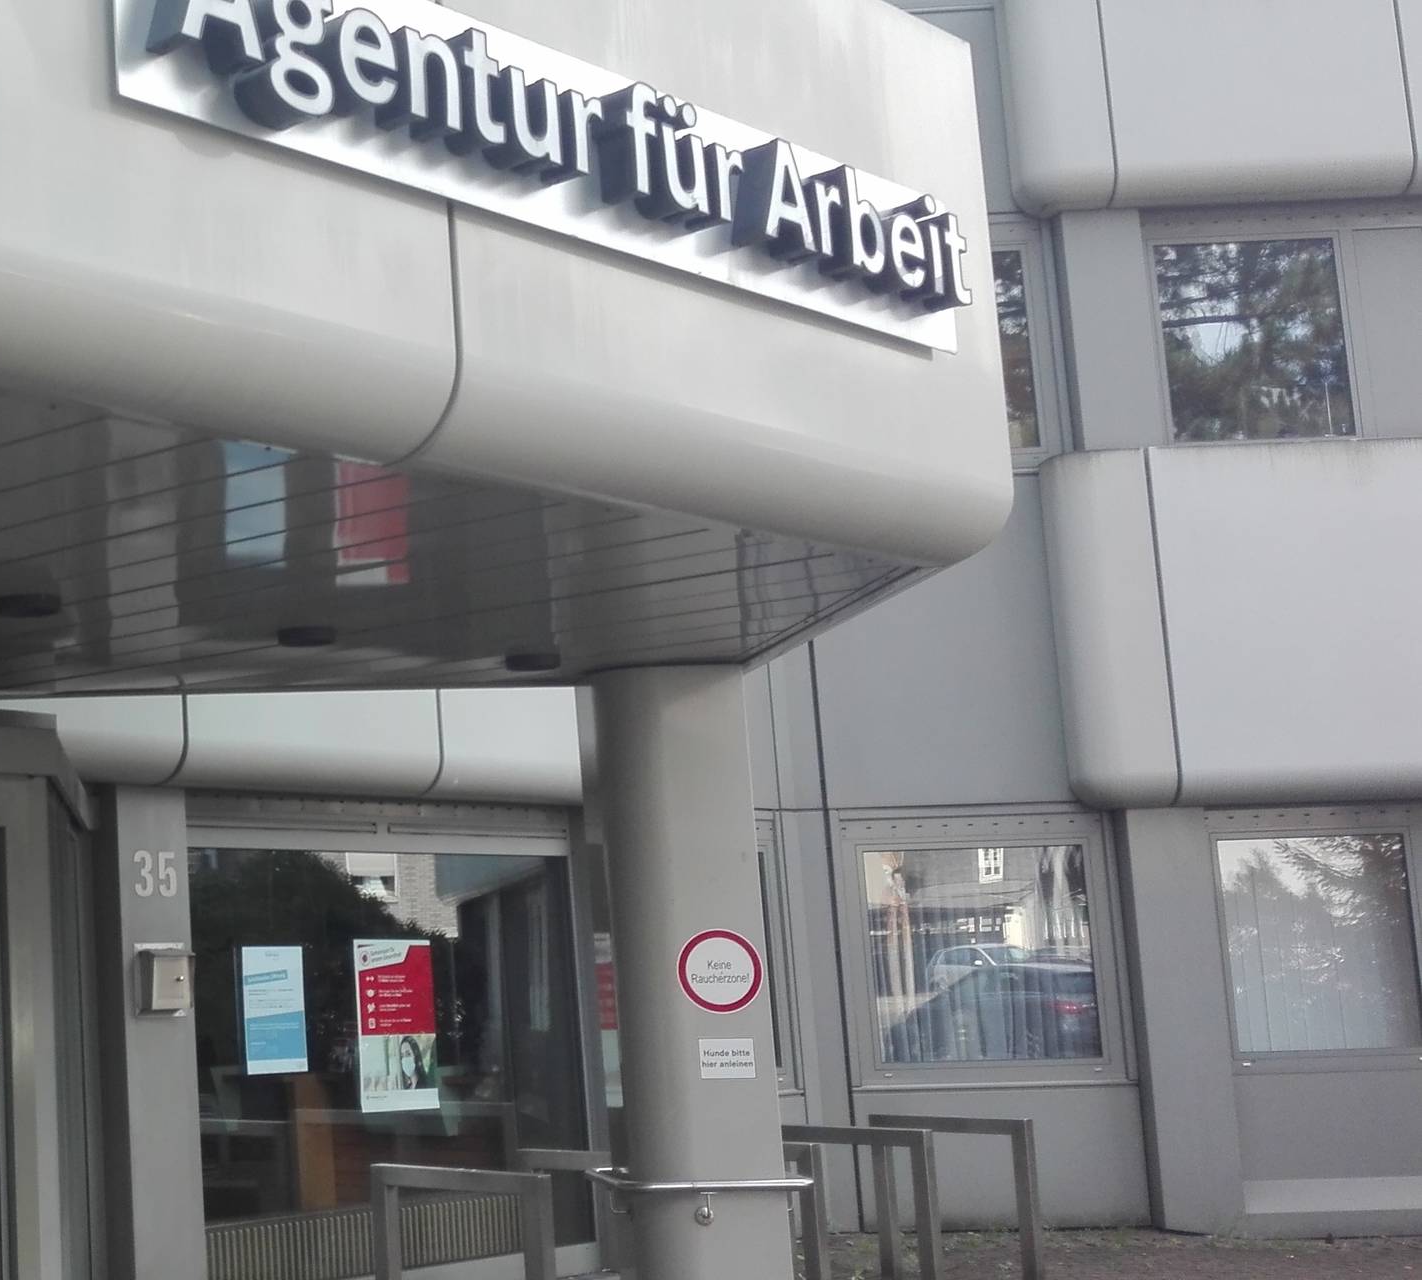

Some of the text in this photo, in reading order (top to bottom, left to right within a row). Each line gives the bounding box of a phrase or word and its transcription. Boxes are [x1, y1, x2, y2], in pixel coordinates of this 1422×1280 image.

[181, 0, 973, 305] Agentur für Arbeit
[134, 850, 177, 897] 35
[707, 960, 732, 971] Keine
[690, 972, 750, 984] Raucherzone!
[703, 1048, 750, 1057] Hunde bitte
[702, 1059, 753, 1068] hier anleinen
